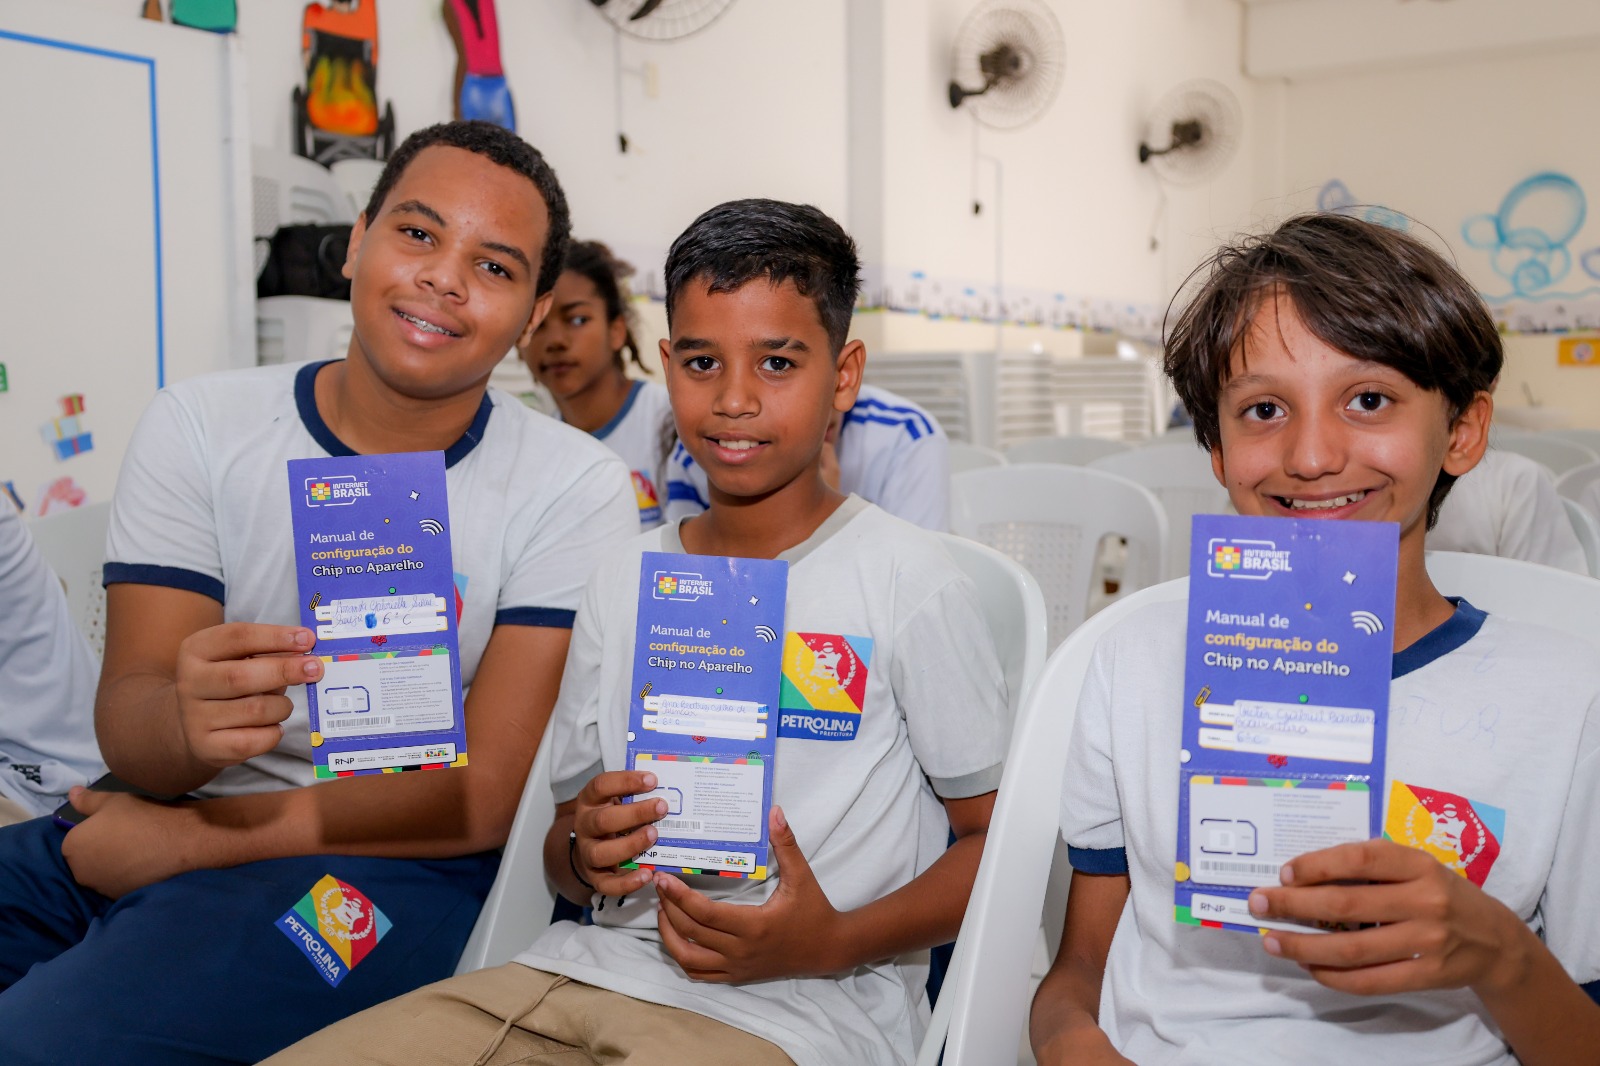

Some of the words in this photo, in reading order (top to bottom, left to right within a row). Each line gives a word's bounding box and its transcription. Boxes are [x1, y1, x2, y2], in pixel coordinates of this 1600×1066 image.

[332, 481, 369, 489] INTERNET
[333, 487, 371, 499] BRASIL
[310, 531, 356, 544] Manual
[359, 530, 375, 541] de
[311, 545, 394, 561] configuração
[396, 544, 414, 555] do
[1243, 548, 1291, 559] INTERNET
[312, 565, 343, 577] Chip
[346, 565, 364, 575] no
[366, 560, 424, 574] Aparelho
[1242, 557, 1293, 572] BRASIL
[678, 585, 714, 596] BRASIL
[679, 579, 713, 587] INTERNET
[1205, 609, 1265, 628] Manual
[1268, 614, 1290, 629] de
[650, 624, 693, 637] Manual
[696, 627, 711, 638] de
[649, 641, 727, 656] configuração
[729, 646, 746, 657] do
[1204, 633, 1313, 653] configuração
[1316, 638, 1339, 654] do
[648, 656, 677, 670] Chip
[679, 660, 696, 670] no
[697, 660, 753, 674] Aparelho
[1203, 651, 1243, 671] Chip
[1246, 657, 1270, 671] no
[1272, 656, 1351, 677] Aparelho
[781, 714, 854, 734] PETROLINA
[335, 757, 355, 766] RNP
[1200, 901, 1226, 913] RNP
[284, 915, 341, 979] PETROLINA
[311, 952, 335, 982] PREFEITURA
